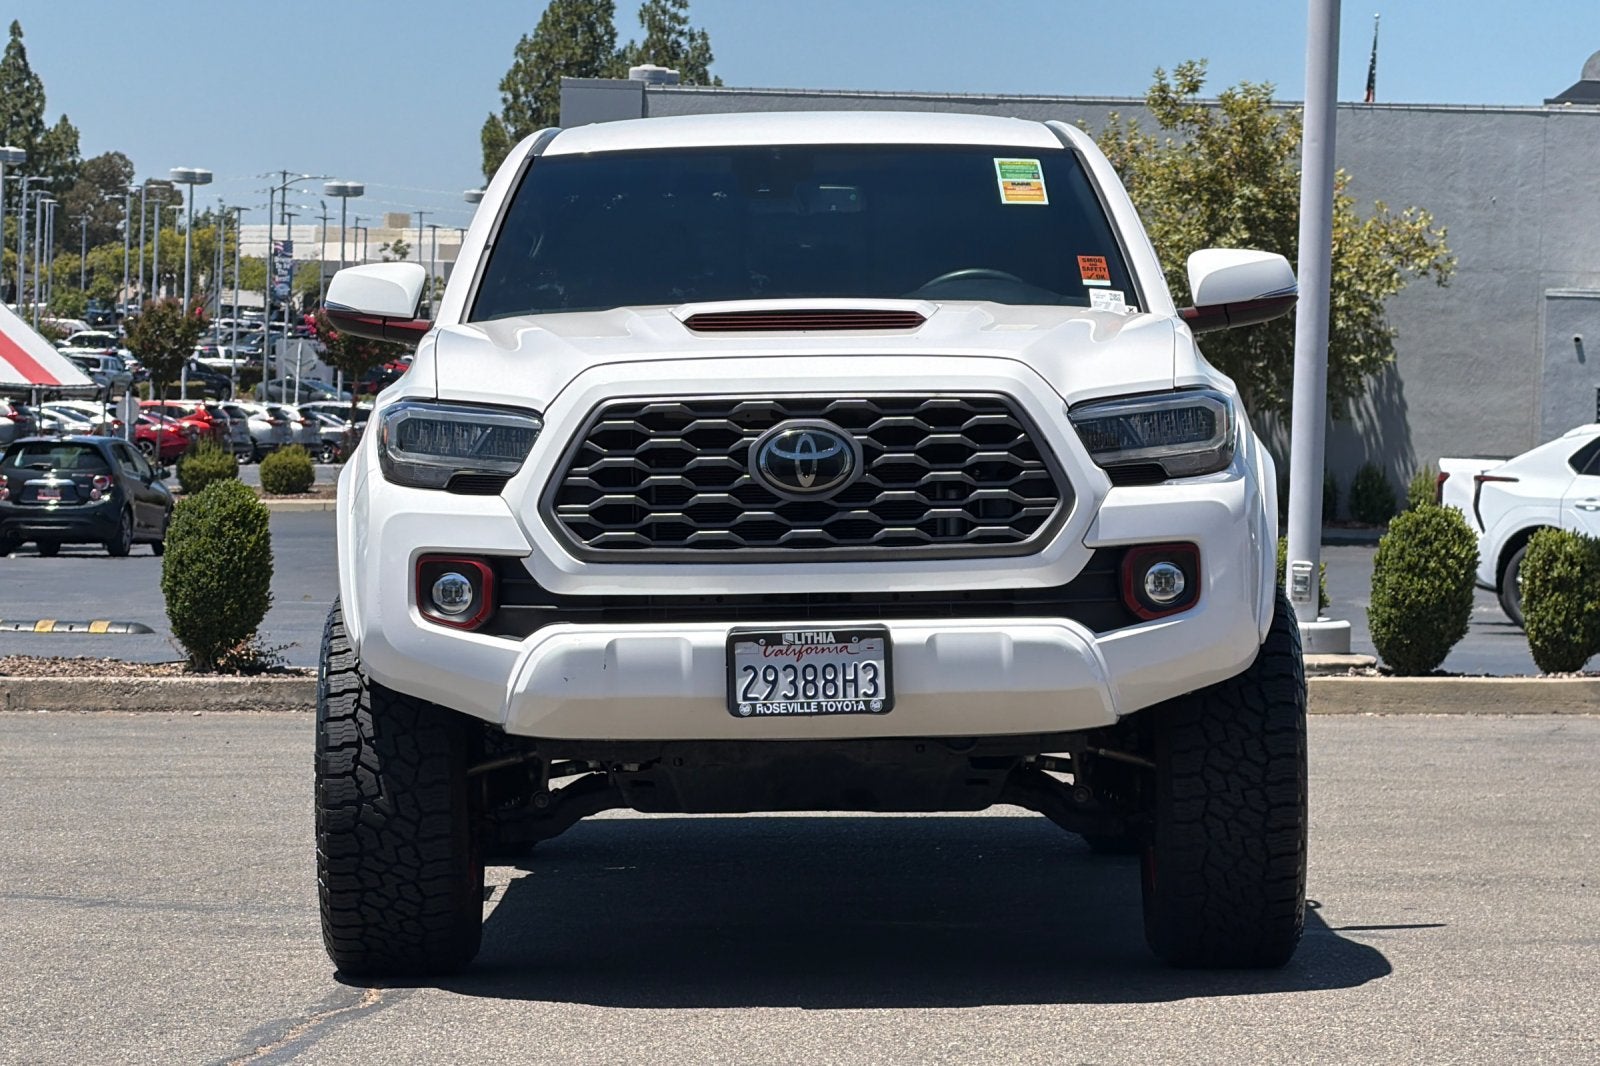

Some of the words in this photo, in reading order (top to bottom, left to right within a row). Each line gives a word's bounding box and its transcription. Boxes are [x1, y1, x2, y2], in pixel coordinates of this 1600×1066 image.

[794, 632, 836, 645] LITHIA
[762, 643, 860, 662] California
[742, 662, 879, 701] 29388H3
[756, 702, 818, 714] ROSEVILLE
[821, 700, 866, 713] TOYOTA
